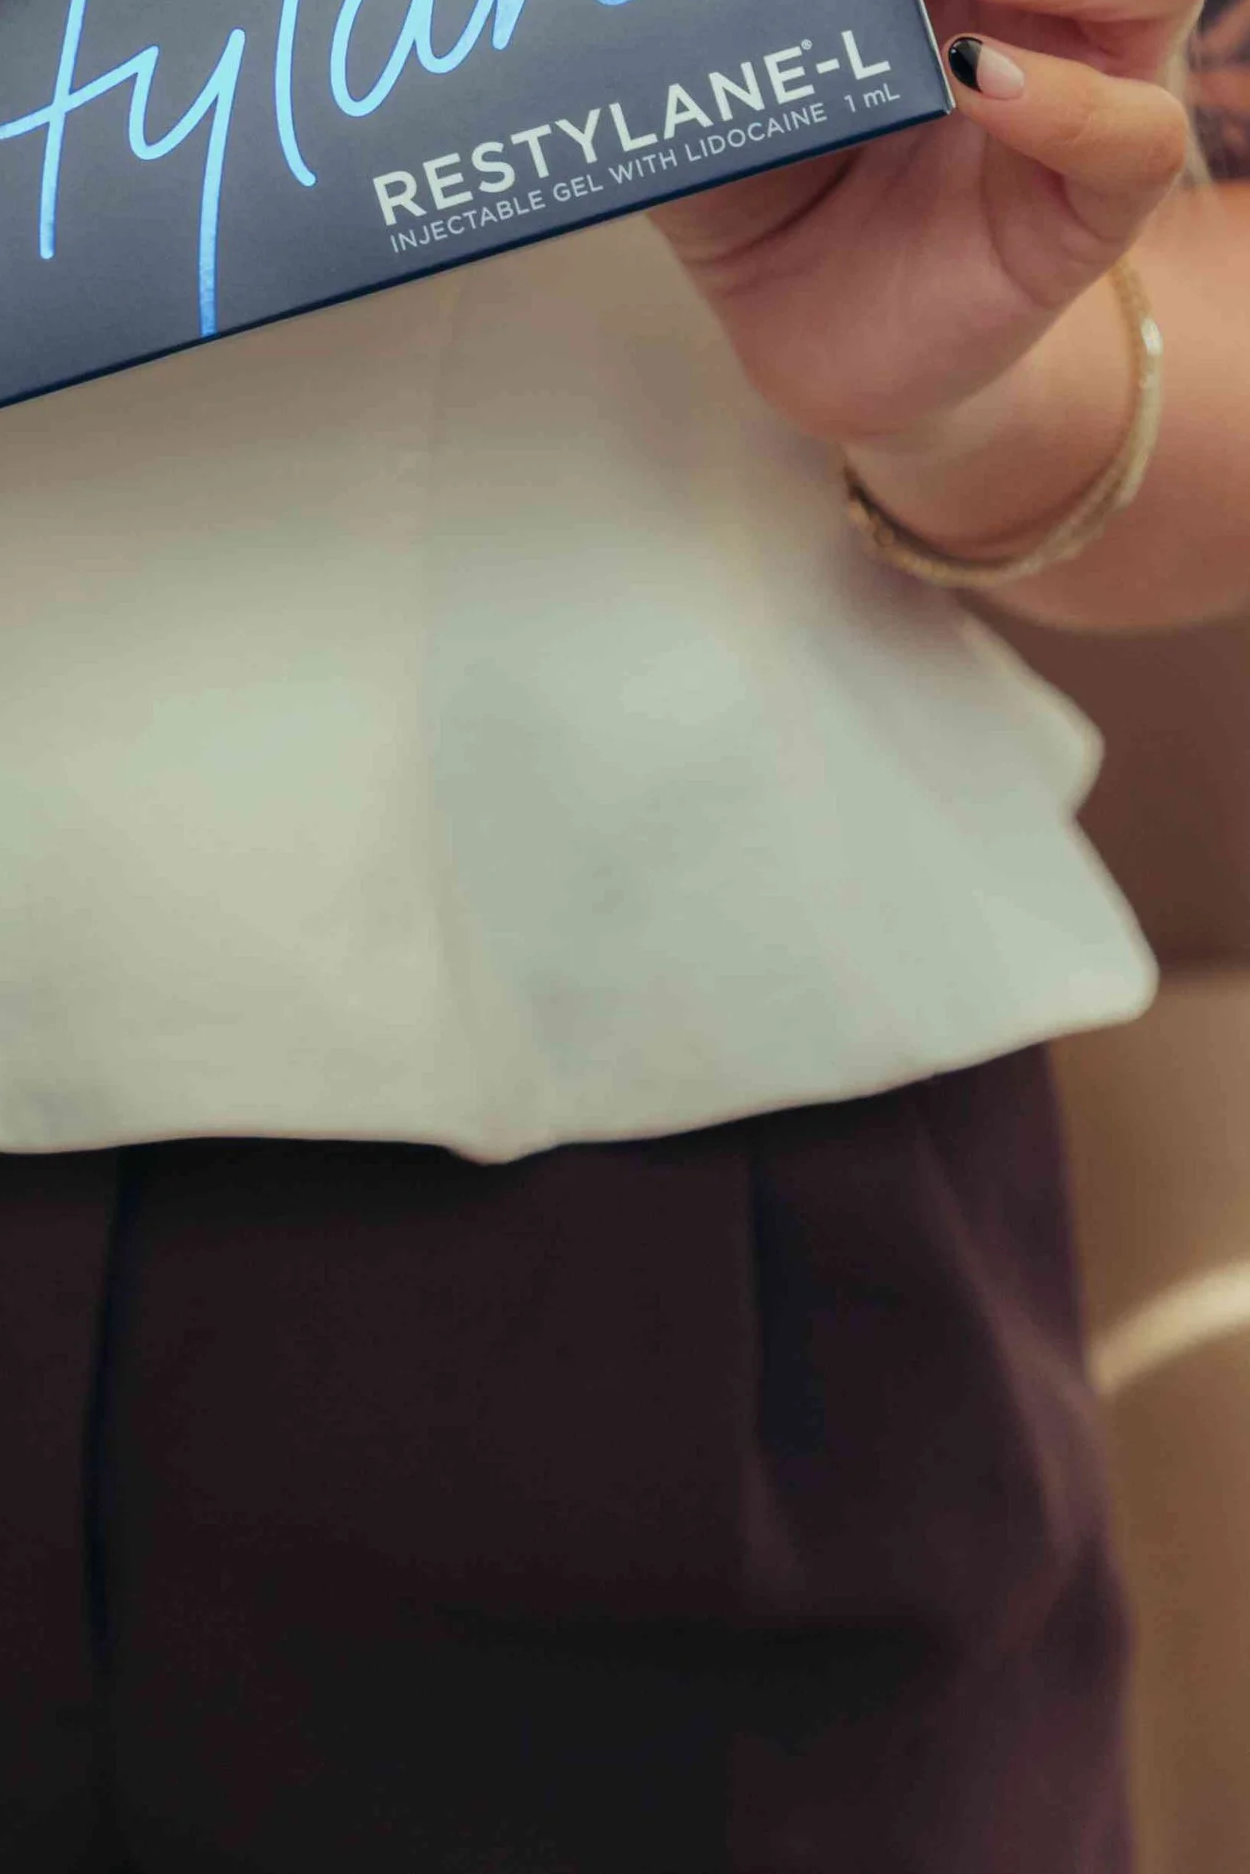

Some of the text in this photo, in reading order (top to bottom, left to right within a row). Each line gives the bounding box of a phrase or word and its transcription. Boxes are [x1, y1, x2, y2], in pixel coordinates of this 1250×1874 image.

[389, 82, 901, 254] INJECTABLE GEL WITH LIDOCAINE 1 mL
